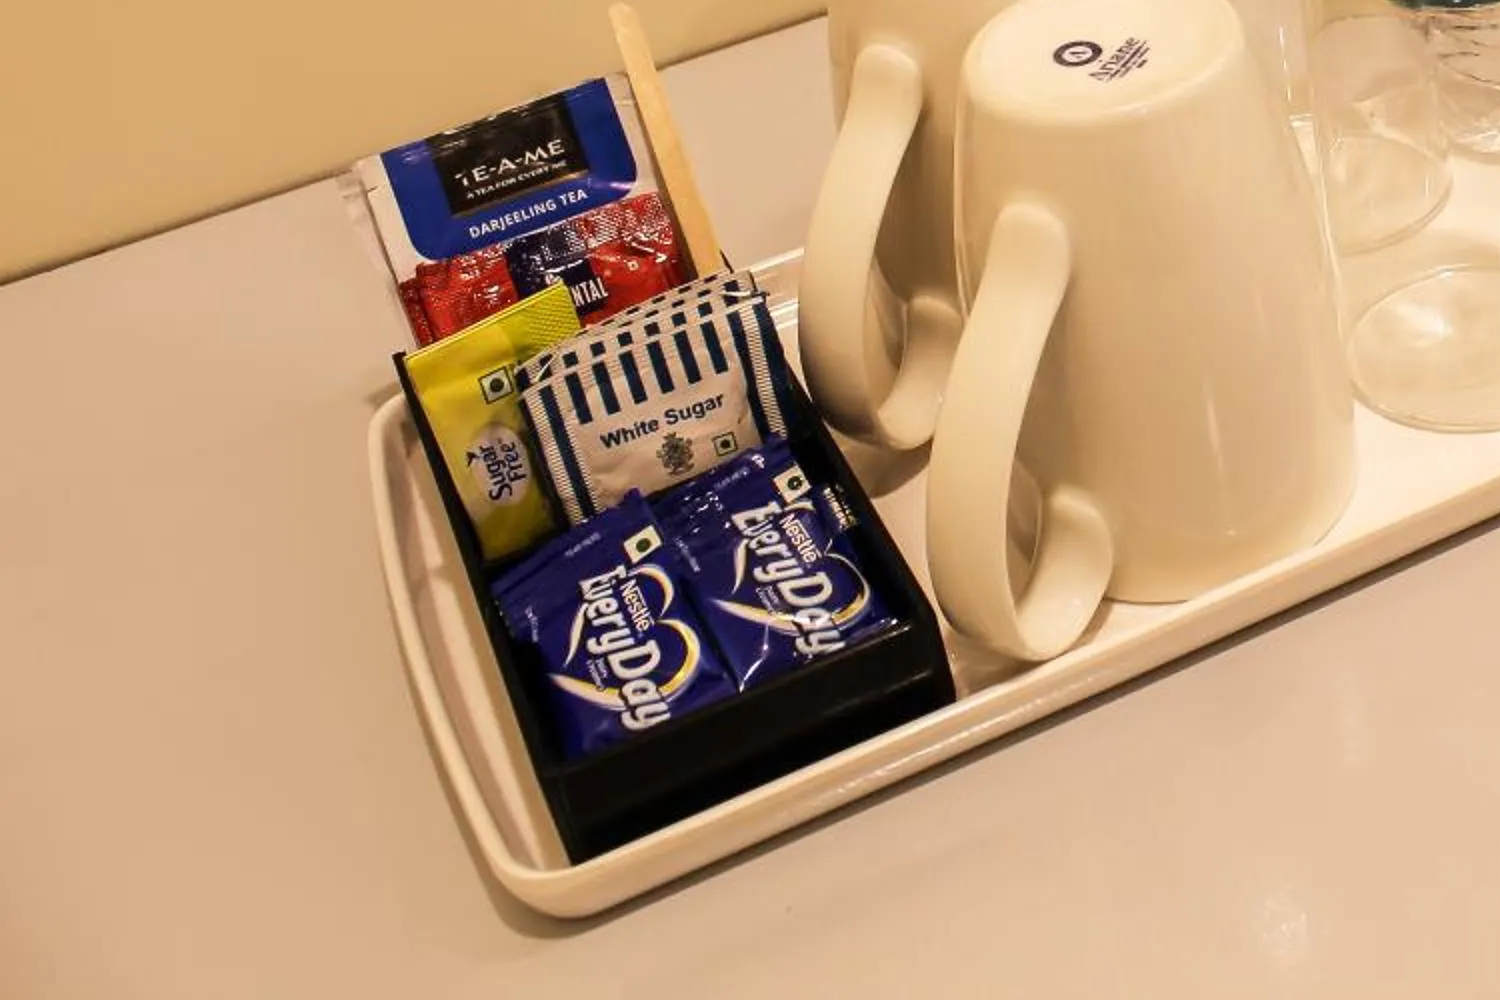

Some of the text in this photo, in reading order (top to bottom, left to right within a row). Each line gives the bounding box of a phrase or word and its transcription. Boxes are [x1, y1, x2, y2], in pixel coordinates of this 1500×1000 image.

[468, 188, 589, 239] DARJEELING TEA
[571, 277, 609, 307] NTAL
[600, 394, 724, 449] White Sugar
[479, 445, 513, 500] Sugar
[500, 442, 527, 482] Free
[731, 501, 846, 655] EveryDay
[578, 565, 671, 731] EveryDay
